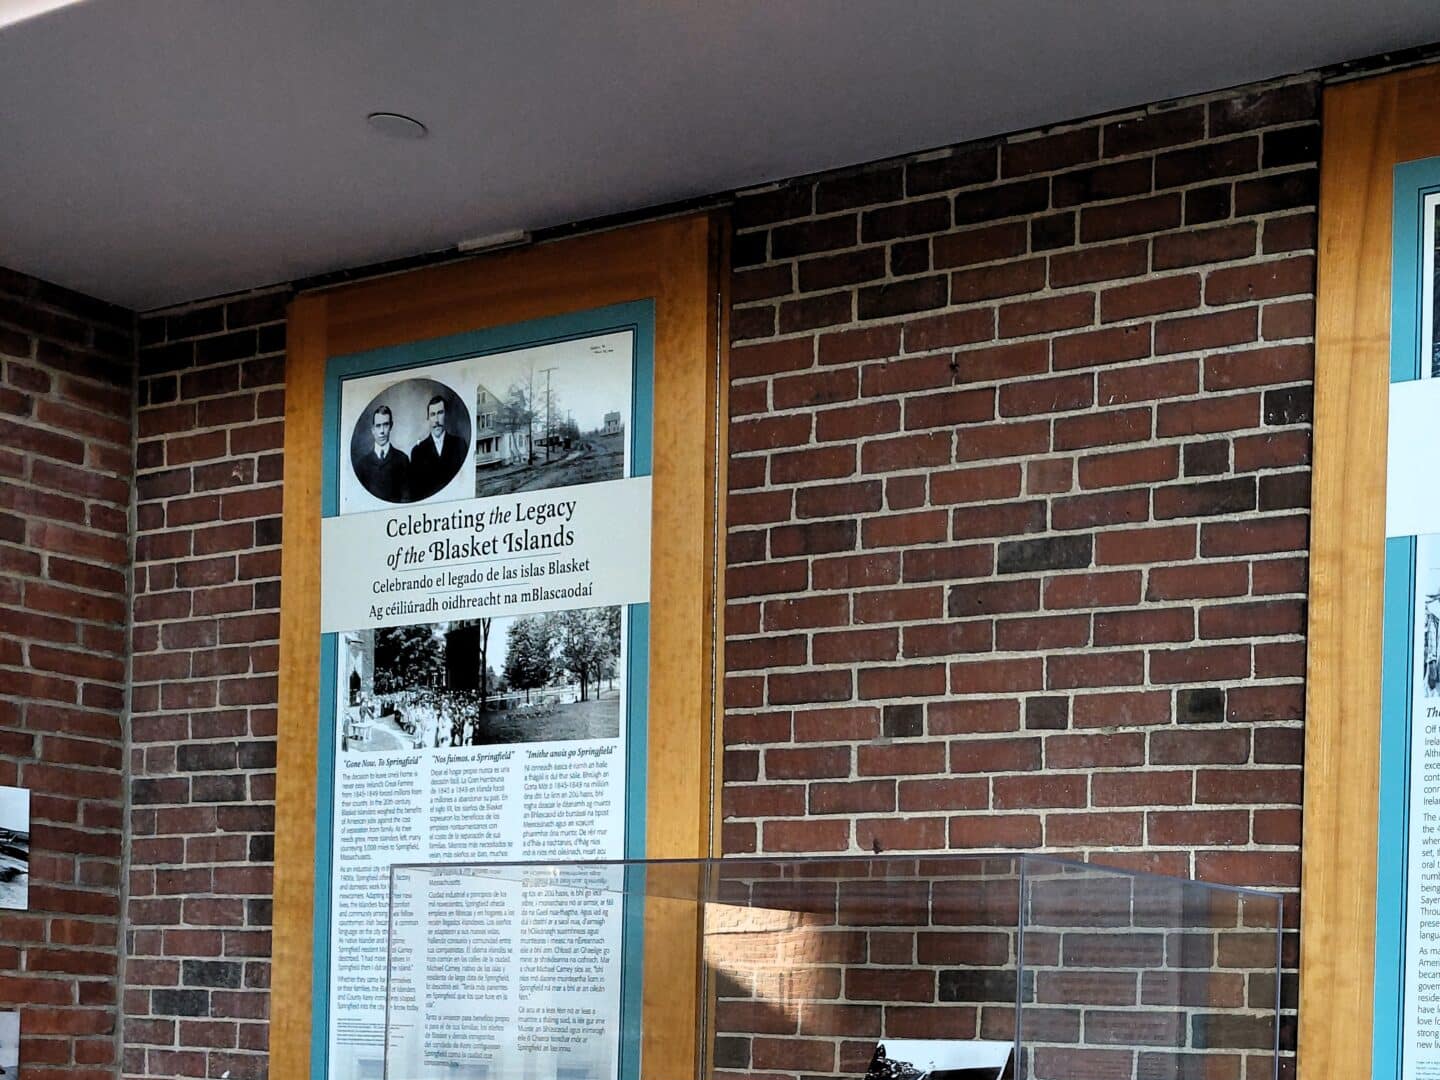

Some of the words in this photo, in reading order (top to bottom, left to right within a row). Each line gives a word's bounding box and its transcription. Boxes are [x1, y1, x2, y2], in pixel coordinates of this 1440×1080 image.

[386, 508, 485, 538] Celebrating
[488, 503, 511, 525] the
[515, 500, 576, 526] Legacy
[386, 544, 403, 572] of
[403, 543, 425, 564] the
[428, 535, 498, 561] Blasket
[502, 526, 574, 553] Islands
[372, 573, 433, 594] Celebrando
[435, 571, 445, 587] el
[447, 568, 483, 590] legado
[486, 566, 499, 581] de
[502, 564, 517, 580] las
[520, 561, 545, 578] islas
[548, 556, 589, 575] Blasket
[368, 602, 383, 622] Ag
[385, 596, 438, 616] céiliúradh
[441, 590, 501, 610] oidhreacht
[503, 593, 517, 604] na
[520, 580, 593, 602] mBlascaodaí
[1424, 724, 1437, 734] Off
[1416, 1041, 1433, 1049] new
